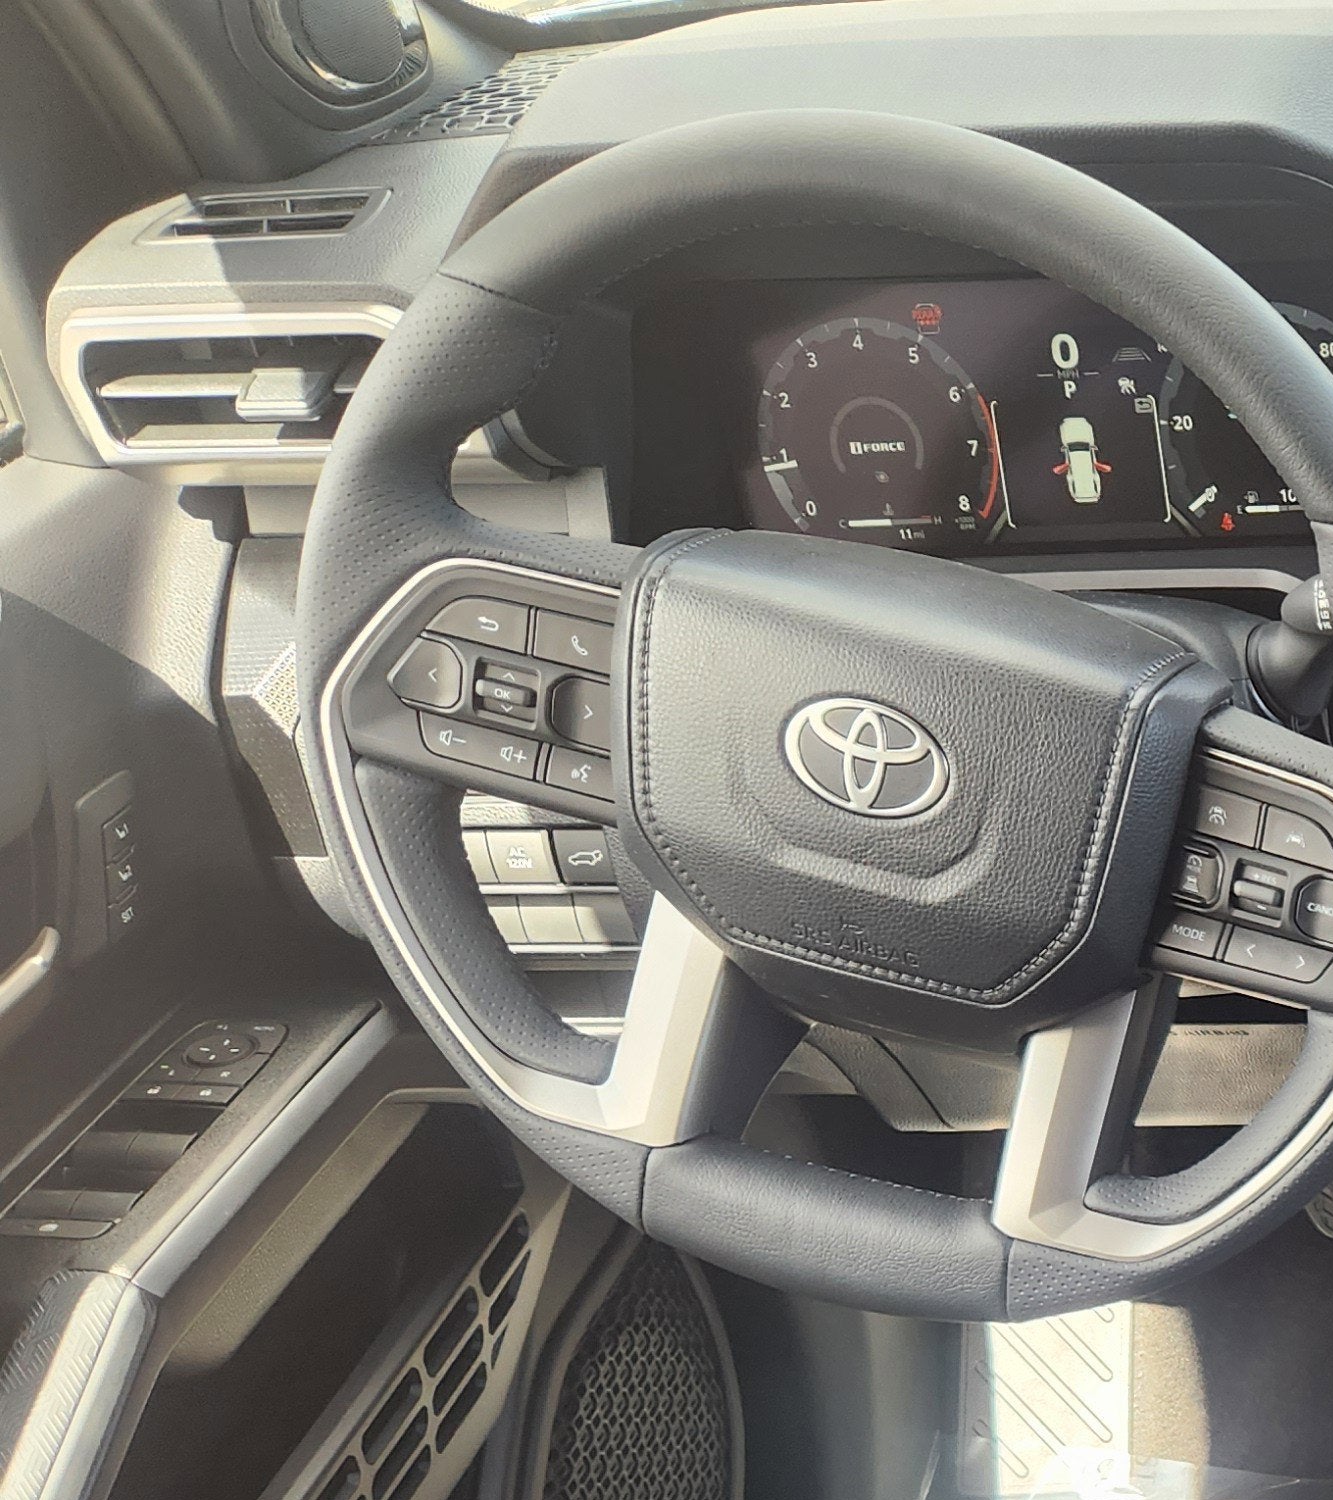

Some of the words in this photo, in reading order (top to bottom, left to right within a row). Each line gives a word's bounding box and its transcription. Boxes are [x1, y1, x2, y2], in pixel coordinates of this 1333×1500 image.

[852, 334, 864, 350] 4
[908, 347, 919, 363] 5
[1051, 333, 1079, 369] 0
[807, 352, 818, 368] 3
[949, 386, 961, 402] 6
[1064, 381, 1077, 399] P
[779, 393, 791, 408] 2
[1172, 415, 1193, 431] 20
[779, 449, 789, 463] 1
[967, 440, 979, 456] 7
[805, 501, 817, 516] 0
[959, 495, 971, 511] 8
[934, 516, 942, 525] H
[899, 528, 913, 541] 11
[494, 688, 511, 700] OK
[1172, 923, 1206, 942] MODE
